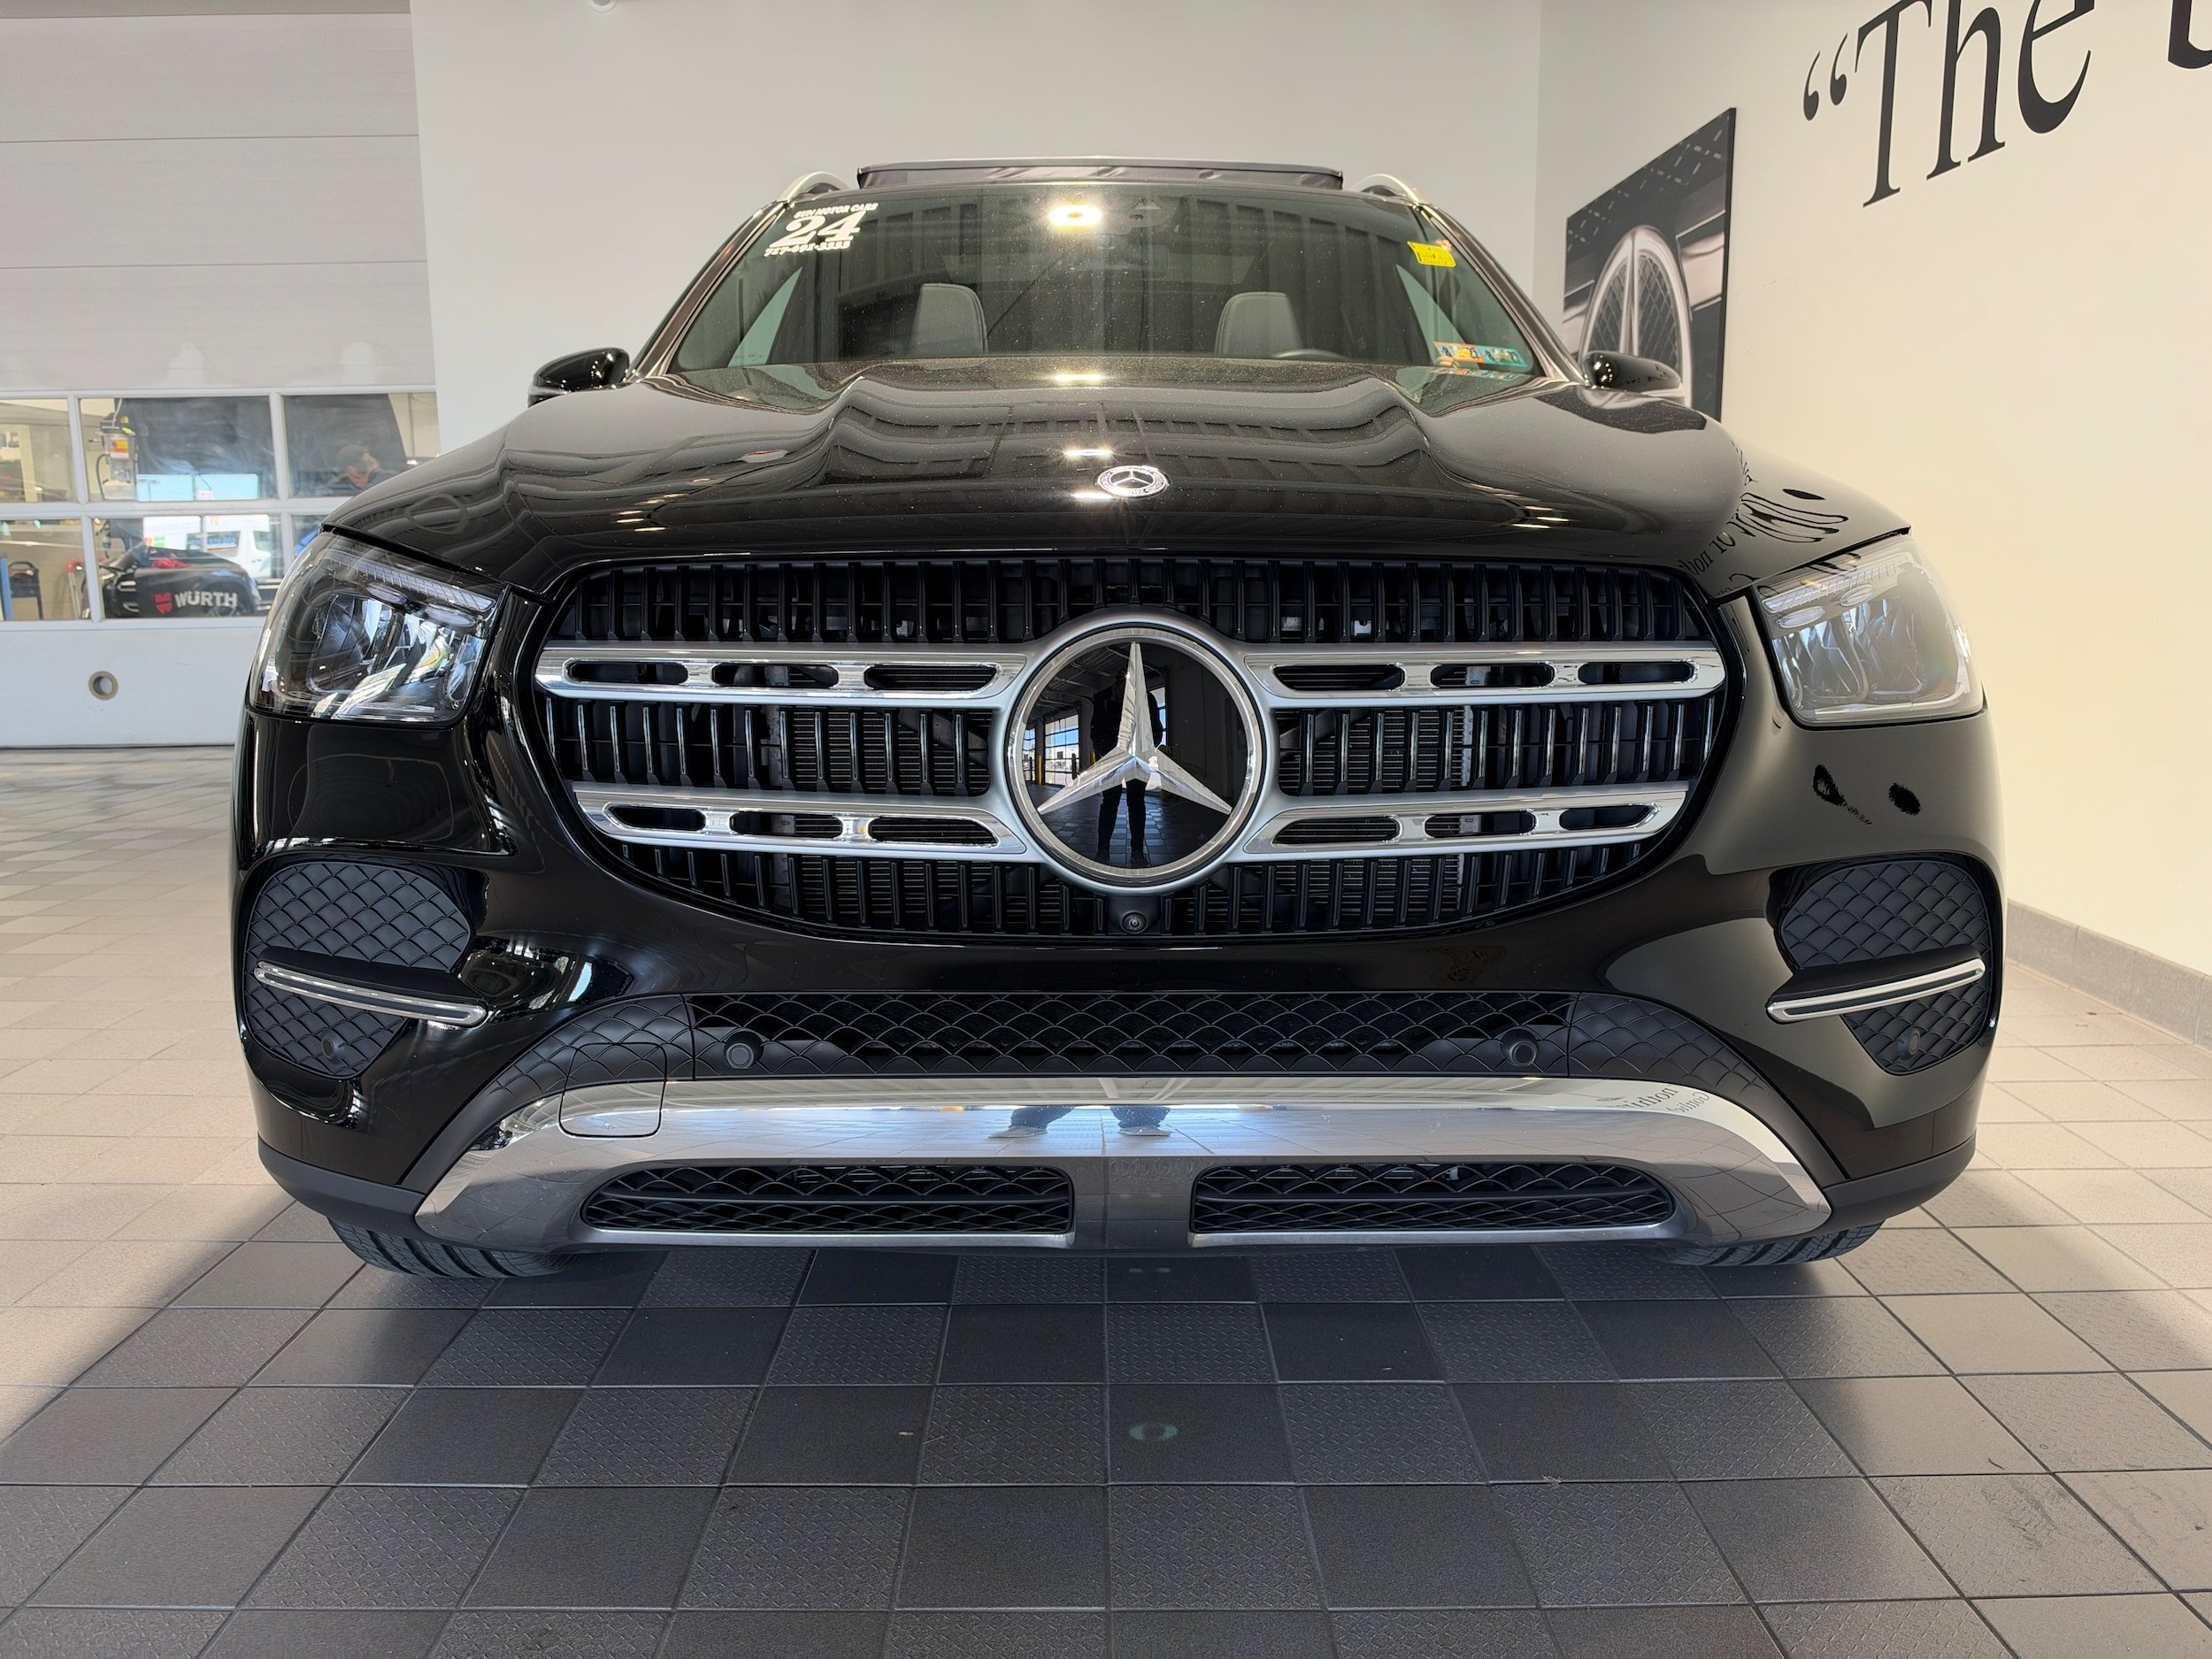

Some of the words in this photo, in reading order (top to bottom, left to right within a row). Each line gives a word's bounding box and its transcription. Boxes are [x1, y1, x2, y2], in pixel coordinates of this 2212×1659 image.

[815, 204, 850, 216] MOTOR
[850, 203, 879, 212] CARS
[769, 211, 867, 248] 24
[174, 590, 238, 608] WÜRTH
